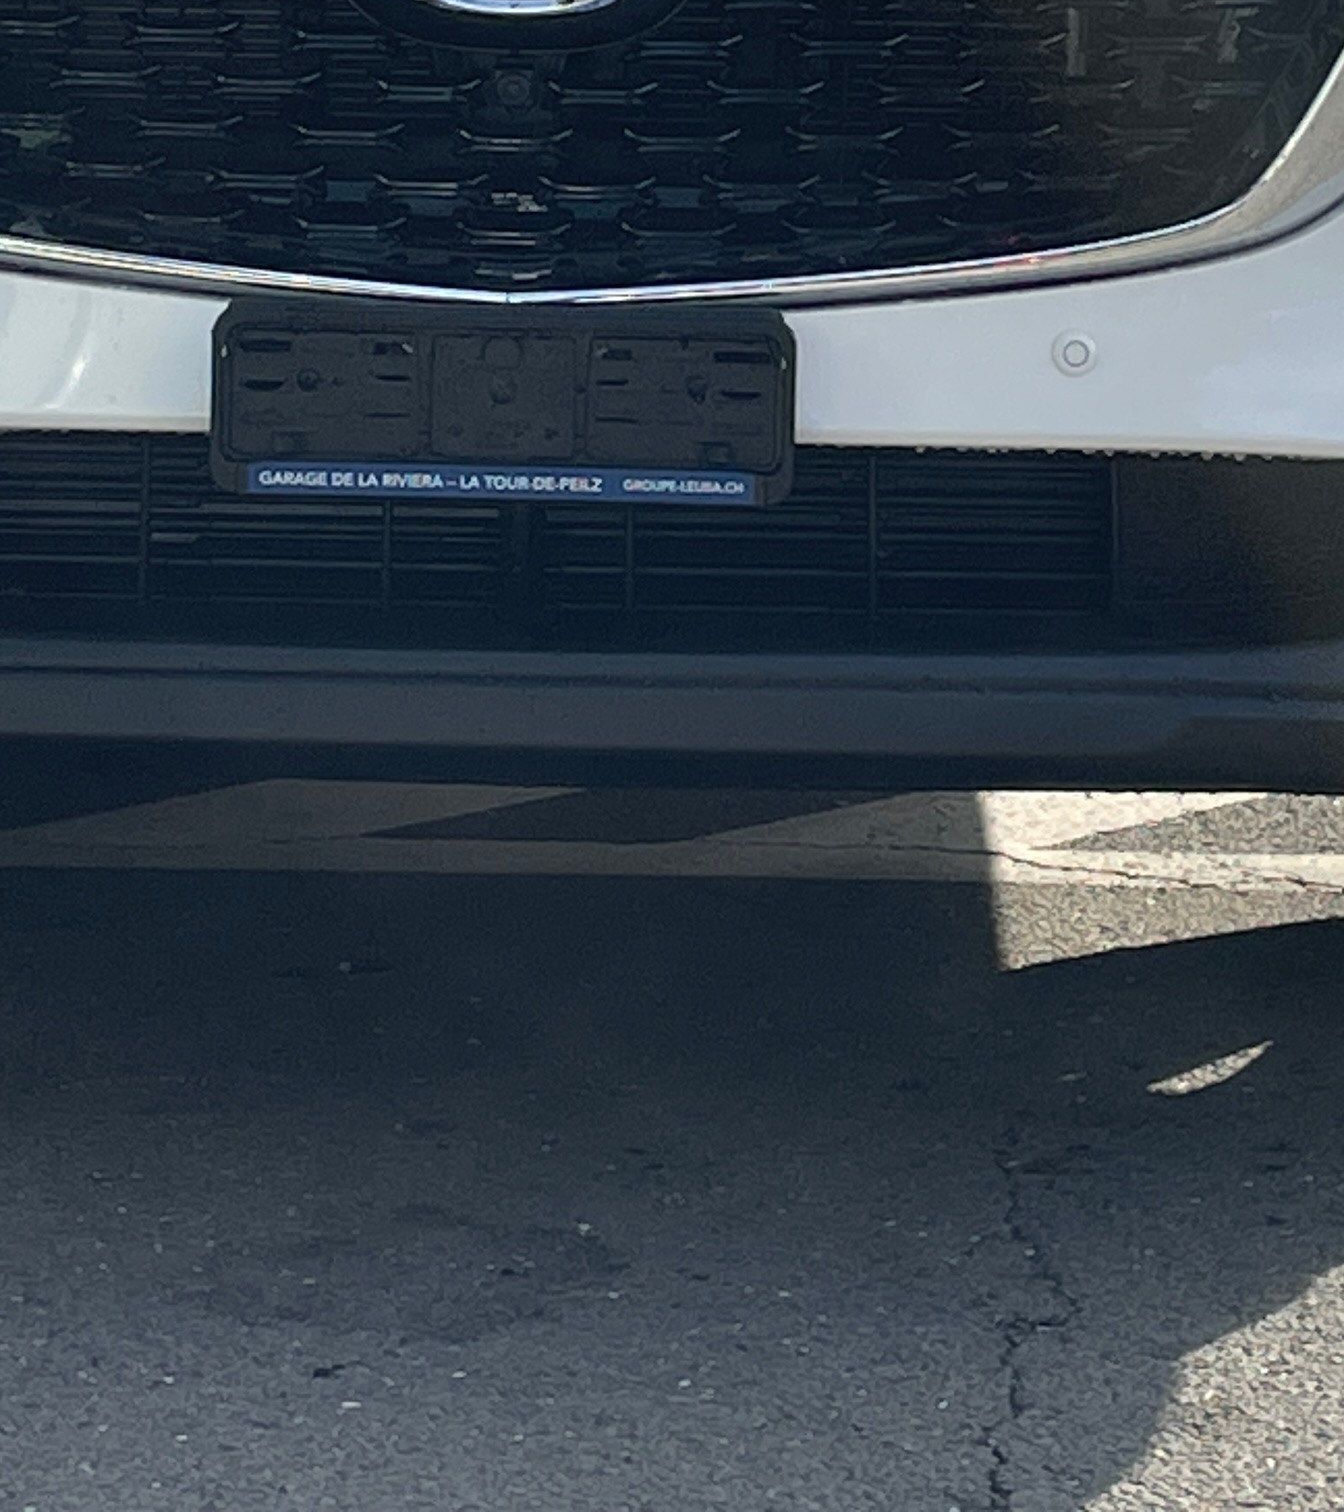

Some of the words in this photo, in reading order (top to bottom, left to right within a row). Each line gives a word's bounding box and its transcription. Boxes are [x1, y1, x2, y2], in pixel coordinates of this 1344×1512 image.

[258, 470, 328, 487] GARAGE
[331, 471, 354, 487] DE
[358, 472, 378, 487] LA
[382, 472, 443, 489] RIVIERA
[460, 474, 480, 489] LA
[483, 474, 603, 492] TOUR-DE-PEILZ
